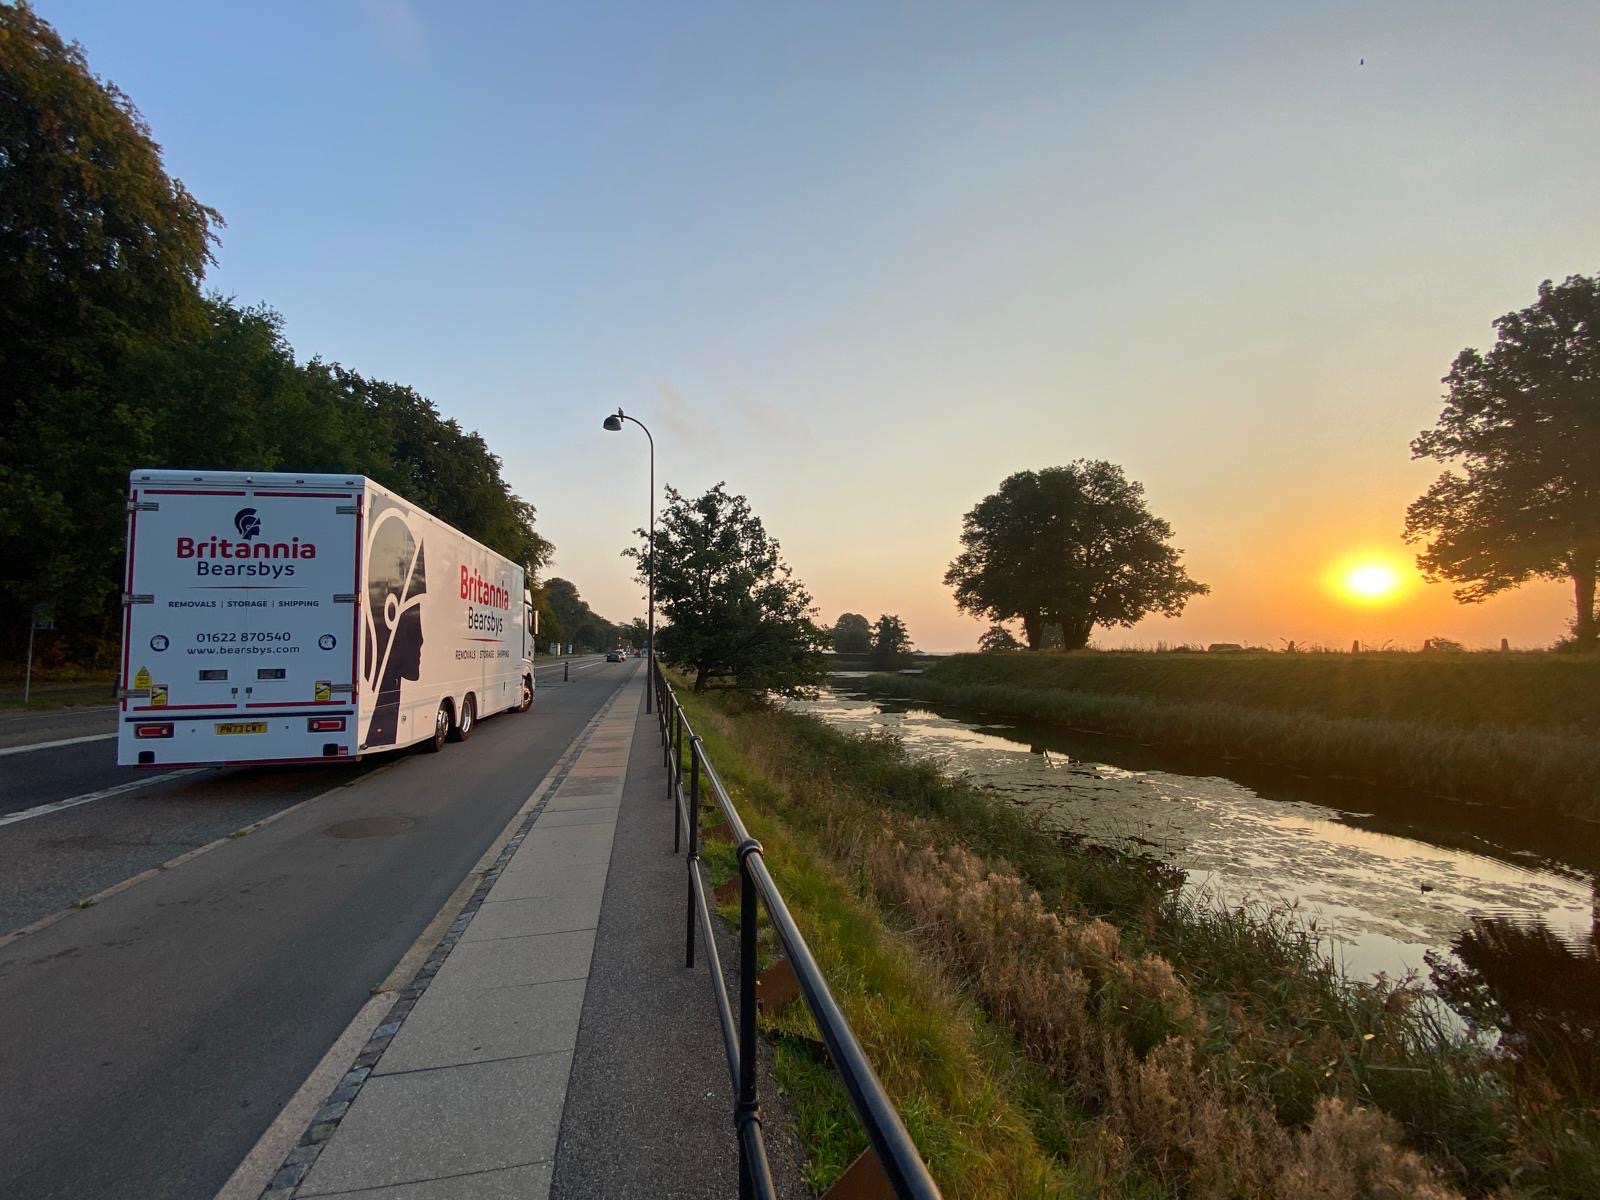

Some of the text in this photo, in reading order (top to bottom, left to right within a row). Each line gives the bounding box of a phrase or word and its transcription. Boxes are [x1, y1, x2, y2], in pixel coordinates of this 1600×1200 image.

[176, 536, 316, 559] Britannia
[197, 561, 295, 579] Bearsbys
[460, 565, 509, 610] Britannia
[227, 600, 268, 608] STORAGE
[278, 600, 319, 608] SHIPPING
[468, 607, 503, 636] Bearsbys
[196, 632, 292, 643] 01622 870540
[187, 645, 300, 655] www.bearsbys.com
